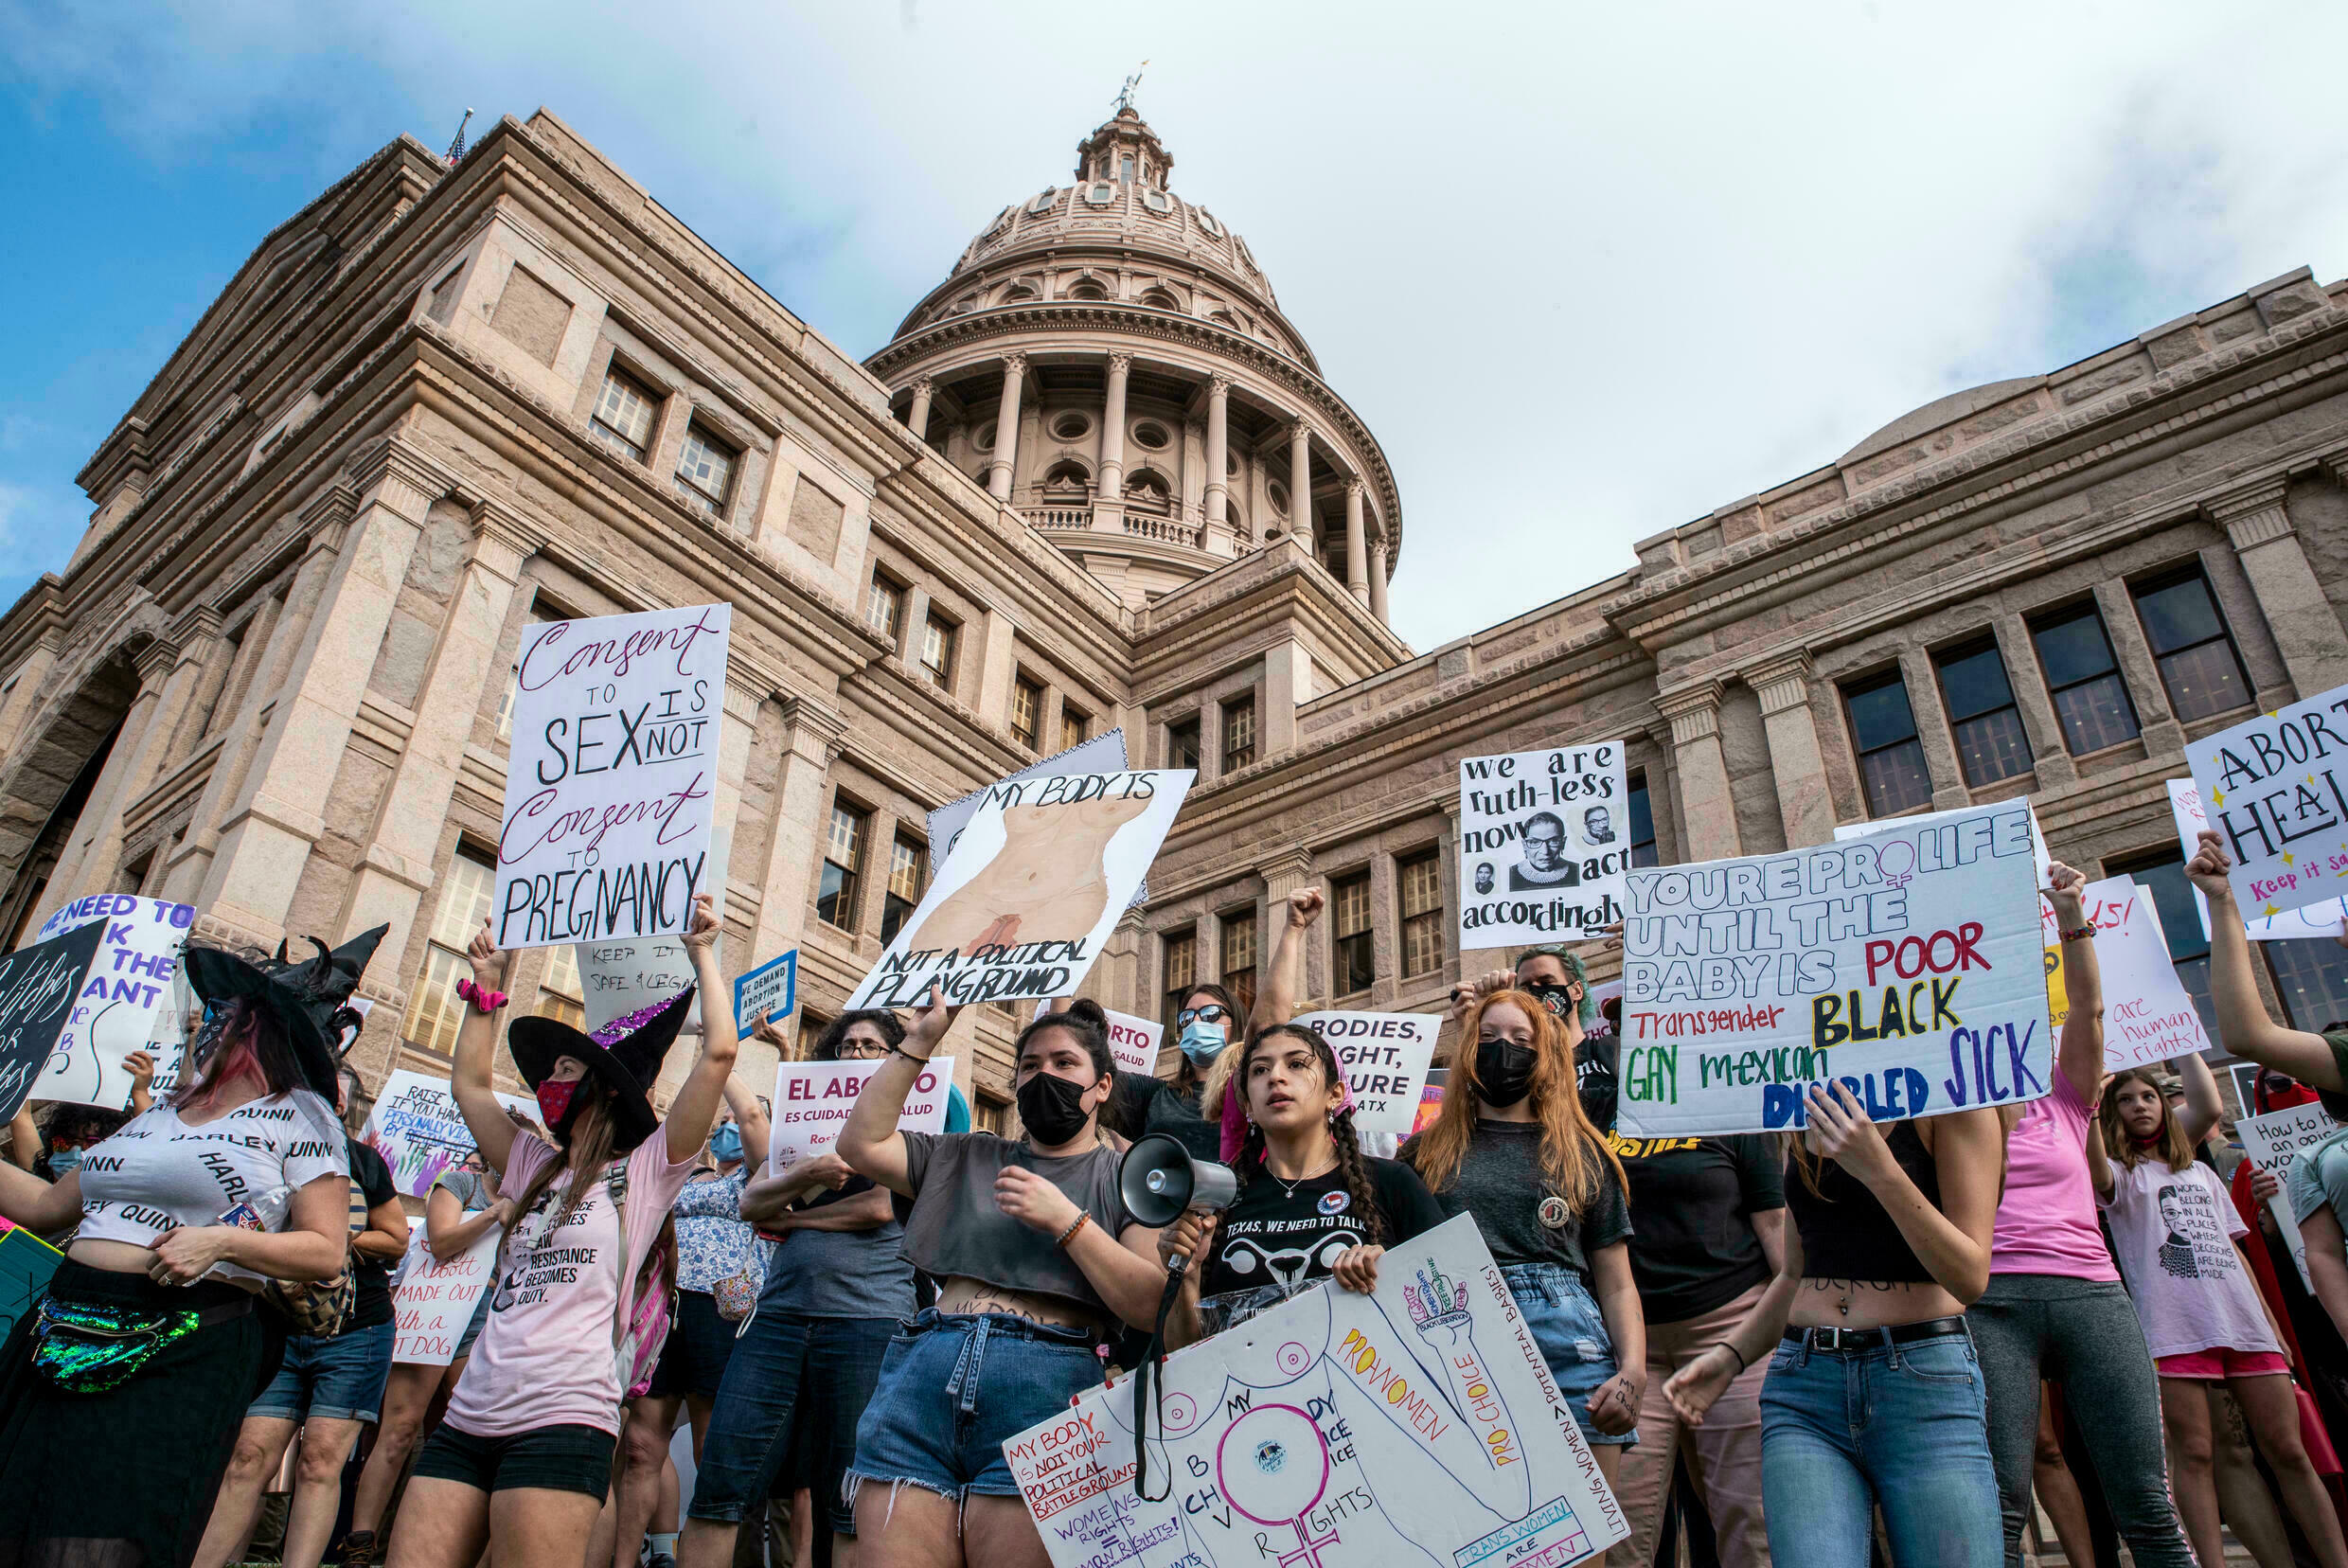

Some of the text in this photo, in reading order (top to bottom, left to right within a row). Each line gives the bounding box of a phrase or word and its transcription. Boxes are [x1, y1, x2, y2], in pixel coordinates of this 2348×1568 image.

[520, 608, 719, 690] Consent
[586, 683, 616, 705] TO
[656, 680, 708, 718] IS
[537, 703, 650, 785] SEX
[646, 721, 708, 758] NOT
[1465, 746, 1612, 779] we are
[979, 773, 1159, 812] MY BODY IS
[499, 772, 708, 864] Consent
[1464, 821, 1528, 853] now
[568, 847, 599, 869] TO
[1582, 848, 1630, 881] act
[1627, 858, 1800, 914] YOURE
[2250, 871, 2297, 901] Keep
[2304, 862, 2320, 879] it
[62, 894, 138, 922] NEED
[154, 901, 197, 929] TO
[499, 851, 705, 945] PREGNANCY
[1463, 894, 1624, 937] accordingly
[1626, 887, 1908, 957] UNTIL THE
[113, 948, 177, 982] THE
[592, 947, 635, 964] KEEP
[880, 938, 1088, 973] NOT A POLITICAL
[1625, 954, 1770, 1004] BABY
[1778, 951, 1836, 995] IS
[1864, 920, 1992, 987] POOR
[82, 976, 162, 1009] ANT
[591, 973, 630, 991] SAFE
[754, 967, 786, 990] DEMAND
[861, 966, 1070, 1009] PLAYGROUND
[743, 983, 780, 1010] ABORTION
[2113, 998, 2152, 1023] are
[1811, 976, 1963, 1048] BLACK
[1108, 1025, 1149, 1049] RTO
[1309, 1019, 1423, 1042] BODIES,
[2120, 1011, 2195, 1043] human
[1334, 1046, 1402, 1069] GHT,
[2132, 1026, 2202, 1061] rights!
[1113, 1050, 1145, 1066] SALUD
[1626, 1044, 1678, 1105] GAY
[1944, 1020, 2044, 1108] SICK
[407, 1086, 447, 1105] RAISE
[788, 1078, 815, 1100] EL
[1348, 1074, 1409, 1095] URE
[387, 1096, 408, 1109] IF
[413, 1100, 434, 1116] YOU
[785, 1113, 801, 1123] ES
[804, 1109, 853, 1122] CUIDAD
[1357, 1100, 1386, 1113] ATX
[383, 1109, 448, 1134] PERSONALLY
[383, 1123, 403, 1137] BY
[2255, 1123, 2292, 1140] How
[2296, 1116, 2317, 1131] to
[285, 1141, 333, 1159] UINN
[407, 1138, 436, 1157] THE
[2271, 1140, 2293, 1152] an
[198, 1152, 250, 1205] HARL
[2179, 1196, 2212, 1204] BELONG
[2182, 1207, 2214, 1218] IN ALL
[1267, 1221, 1286, 1232] WE
[1287, 1219, 1317, 1231] NEED
[1320, 1216, 1334, 1227] TO
[1337, 1215, 1367, 1232] TALK
[2190, 1231, 2222, 1243] WHERE
[538, 1234, 553, 1250] AW
[531, 1249, 597, 1270] RESISTANCE
[2197, 1256, 2215, 1266] ARE
[525, 1268, 578, 1288] BECOMES
[2200, 1270, 2226, 1279] MADE
[396, 1283, 483, 1302] MADE OUT
[519, 1288, 548, 1304] DUTY.
[1479, 1263, 1518, 1324] BABIES!
[429, 1315, 447, 1329] a
[410, 1336, 452, 1356] DOG
[1515, 1324, 1559, 1405] POTENTIAL
[1227, 1389, 1252, 1420] MY
[1454, 1353, 1521, 1466] PRO-CHOICE
[1009, 1412, 1094, 1467] MY BODY
[1559, 1419, 1595, 1479] WOMEN
[1017, 1468, 1034, 1483] IS
[1063, 1431, 1112, 1461] YOUR
[1023, 1460, 1107, 1503] POLITICAL
[1053, 1492, 1141, 1541] WOMENS
[1589, 1479, 1626, 1537] LIVING
[1078, 1515, 1135, 1544] RIGHTS
[1117, 1517, 1180, 1557] RIGHTS!
[1457, 1501, 1567, 1563] TRANS WOMEN
[1506, 1537, 1539, 1563] ARE
[1521, 1540, 1575, 1568] MEN
